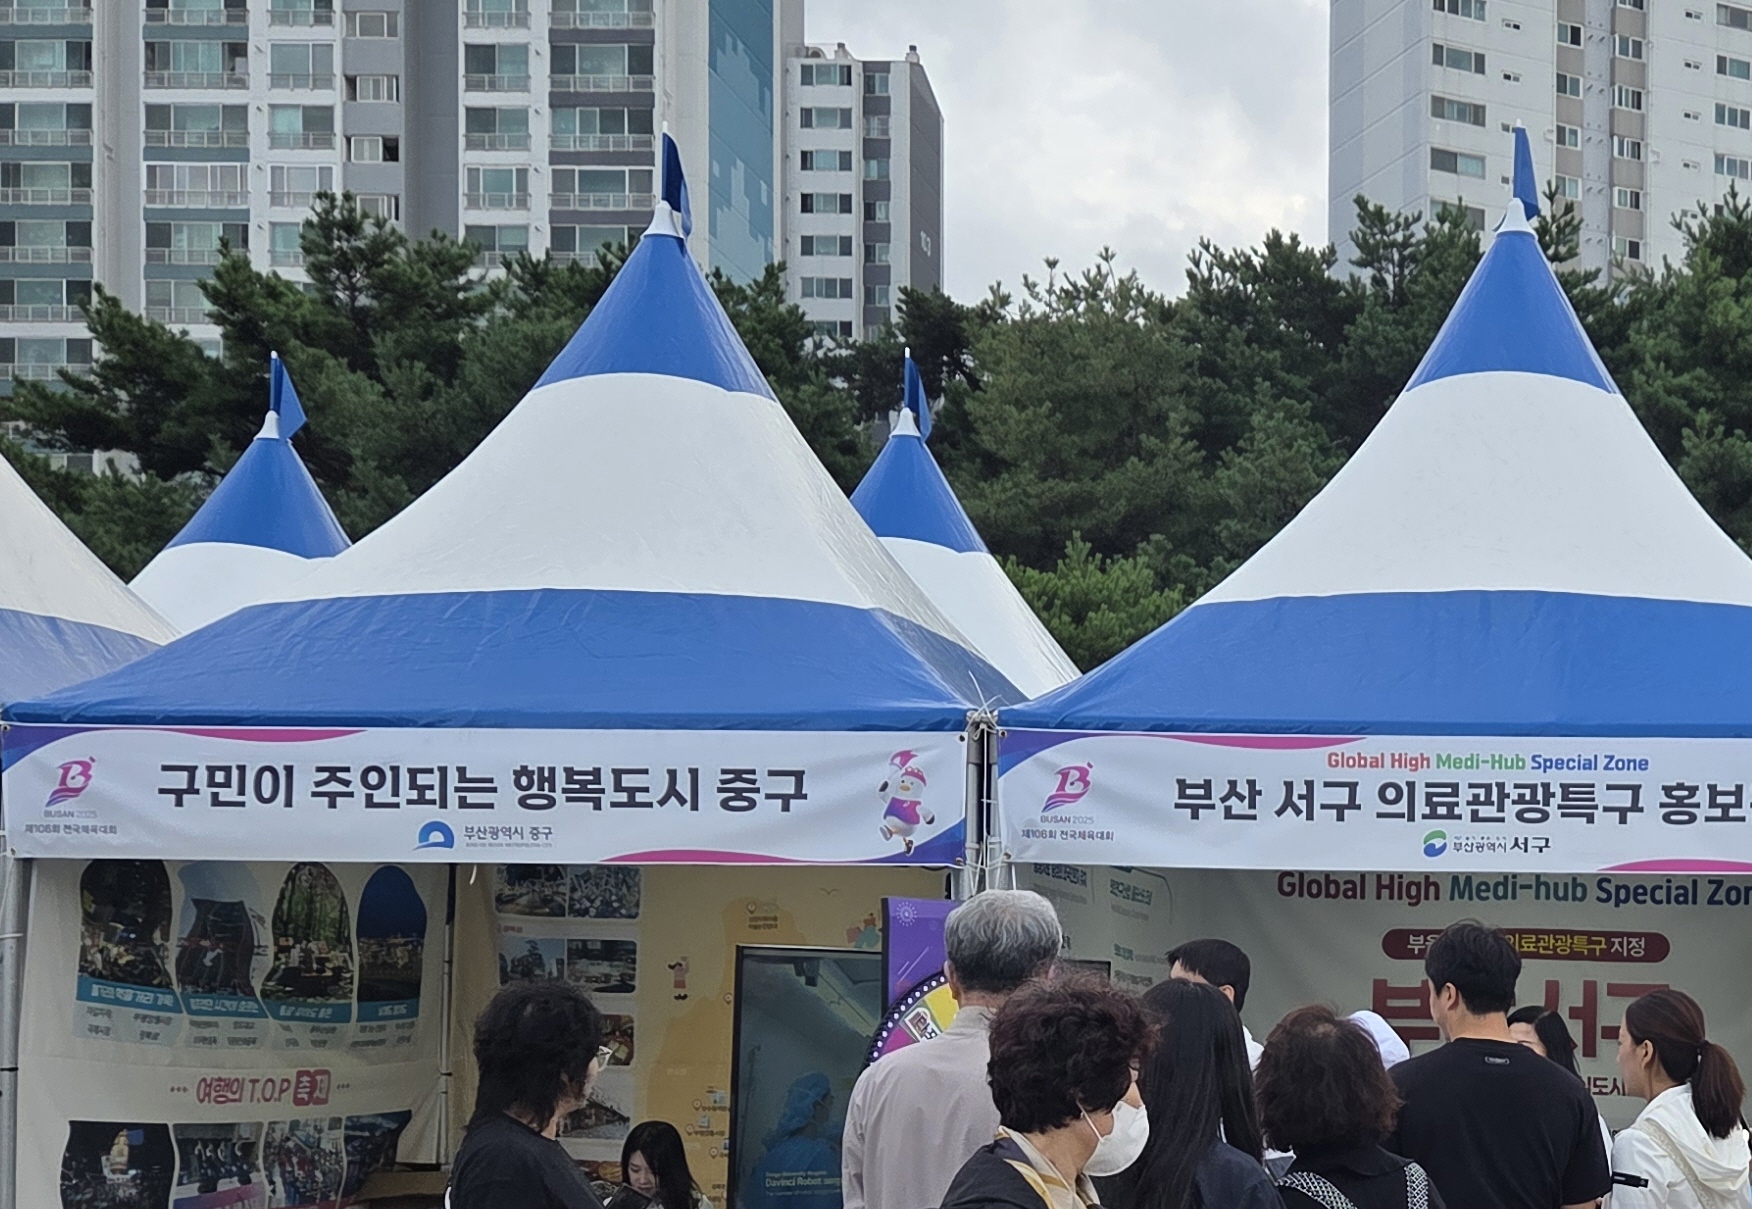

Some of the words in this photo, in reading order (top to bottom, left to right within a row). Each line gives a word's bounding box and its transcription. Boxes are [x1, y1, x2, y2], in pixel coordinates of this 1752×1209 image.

[1328, 752, 1385, 770] Global
[1390, 753, 1430, 772] High
[1436, 753, 1526, 771] Medi-Hub
[1531, 754, 1598, 775] Special
[1603, 755, 1649, 771] Zone
[157, 764, 294, 808] 구민이
[310, 764, 499, 811] 주인되는
[513, 765, 700, 812] 행복도시
[716, 768, 808, 813] 중구
[1174, 778, 1262, 822] 부산
[1274, 779, 1362, 823] 서구
[1376, 780, 1643, 824] 의료관광특구
[1040, 815, 1071, 824] BUSAN
[1072, 816, 1095, 825] 2025
[464, 825, 524, 840] 부산광역시
[529, 826, 553, 840] 중구
[1060, 830, 1114, 841] 전국체육대회
[1453, 842, 1507, 853] 부산광역시
[1510, 837, 1551, 853] 서구
[1277, 872, 1366, 900] Global
[1375, 874, 1440, 907] High
[1450, 874, 1588, 903] Medi-hub
[1596, 876, 1698, 908] Special
[1610, 936, 1646, 957] 지정
